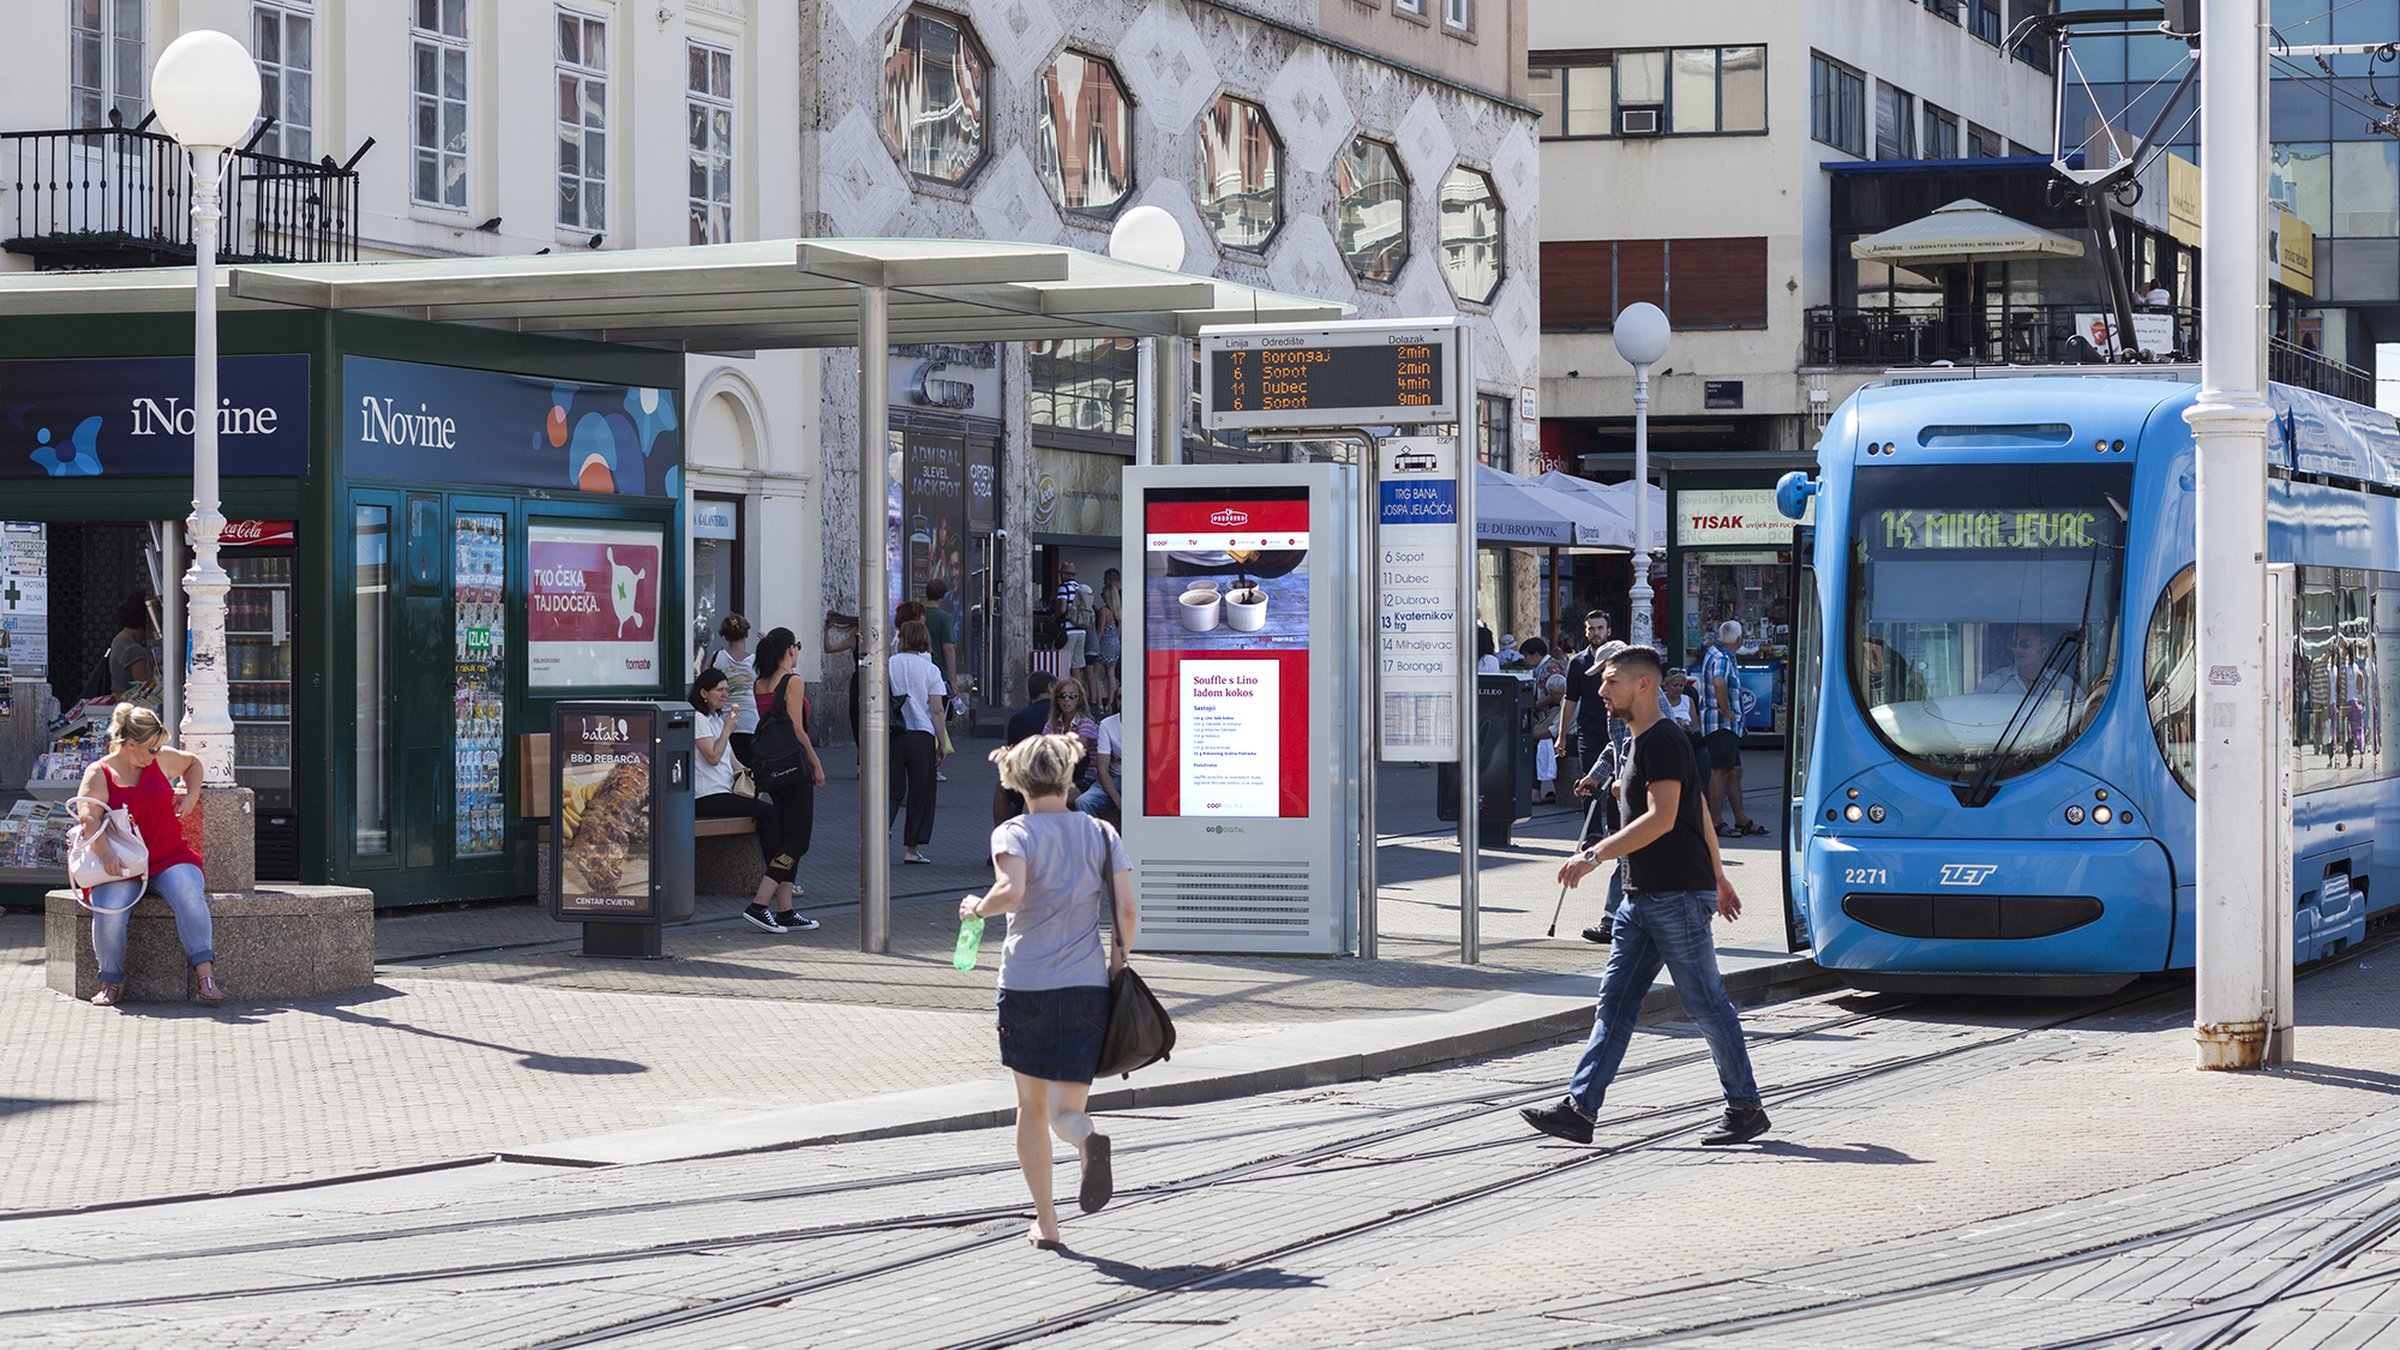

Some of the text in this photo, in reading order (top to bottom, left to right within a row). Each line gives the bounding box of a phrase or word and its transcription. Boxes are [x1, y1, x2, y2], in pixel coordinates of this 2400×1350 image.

[1226, 335, 1425, 350] Linija Odredište Dolazak
[1230, 346, 1431, 365] 17 Borongaj 2min
[1233, 361, 1431, 381] 6 Sopot 2min
[1230, 376, 1431, 396] 11 Dubec 4min
[1233, 392, 1431, 411] 6 Sopot 9min
[361, 395, 456, 450] iNovine
[911, 446, 960, 466] ADMIRAL
[922, 465, 950, 480] 3LEVEL
[970, 464, 995, 480] OPEN
[911, 478, 960, 498] JACKPOT
[1395, 488, 1438, 500] TRG BANA
[1721, 491, 1778, 505] hrvatsk
[1410, 501, 1454, 516] JELAČIĆA
[1491, 522, 1558, 537] DUBROVNIK
[1692, 515, 1744, 530] TISAK
[1746, 521, 1767, 531] uvijek
[1768, 521, 1779, 530] pri
[1880, 511, 2095, 548] 14 MIHALJEVAC
[1679, 530, 1707, 542] ENC
[1385, 551, 1424, 564] 6 Sopot
[22, 580, 46, 589] APOTEKA
[534, 564, 587, 590] TKO ČEKA,
[1383, 572, 1429, 585] 11 Dubec
[534, 590, 600, 613] TAJ DOČEKA.
[1383, 594, 1440, 607] 12 Dubrava
[1381, 611, 1454, 629] 13 Kvaternikov
[1394, 622, 1407, 632] trg
[468, 631, 490, 647] IZLAZ
[1383, 638, 1453, 652] 14 Mihaljevac
[625, 658, 651, 671] tomato
[1383, 659, 1443, 674] 17 Borongaj
[1193, 675, 1258, 685] Souffle s Lino
[1193, 688, 1254, 698] ladom kokos
[570, 753, 641, 765] BBQ REBARCA
[1844, 864, 1999, 887] 2271 ZET
[575, 897, 635, 907] CENTAR CVJETNI
